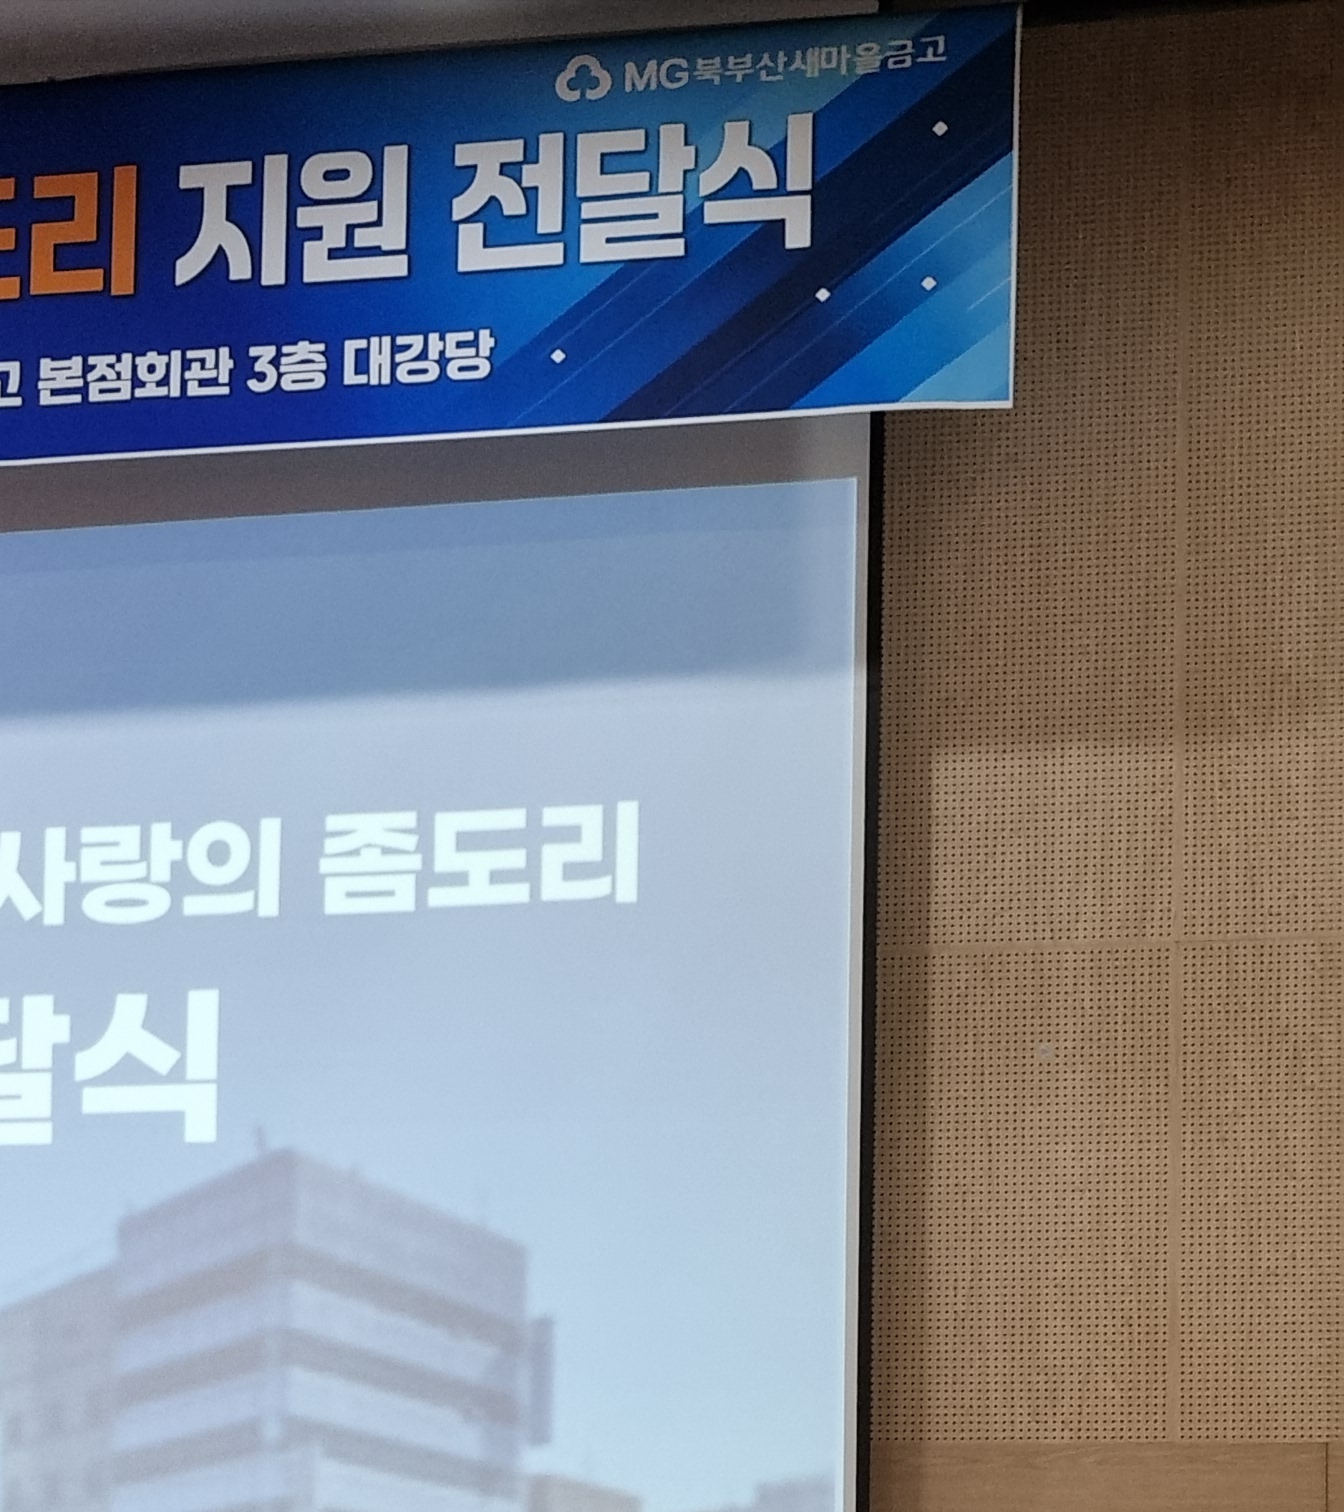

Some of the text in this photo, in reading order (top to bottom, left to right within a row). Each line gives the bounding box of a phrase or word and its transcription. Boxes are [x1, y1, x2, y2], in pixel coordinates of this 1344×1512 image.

[624, 36, 948, 93] MG북부산새마을금고
[174, 143, 411, 287] 지원
[451, 111, 815, 274] 전달식
[38, 347, 234, 404] 본점회관
[247, 340, 328, 394] 3층
[343, 328, 496, 387] 대강당
[319, 800, 640, 915] 좀도리
